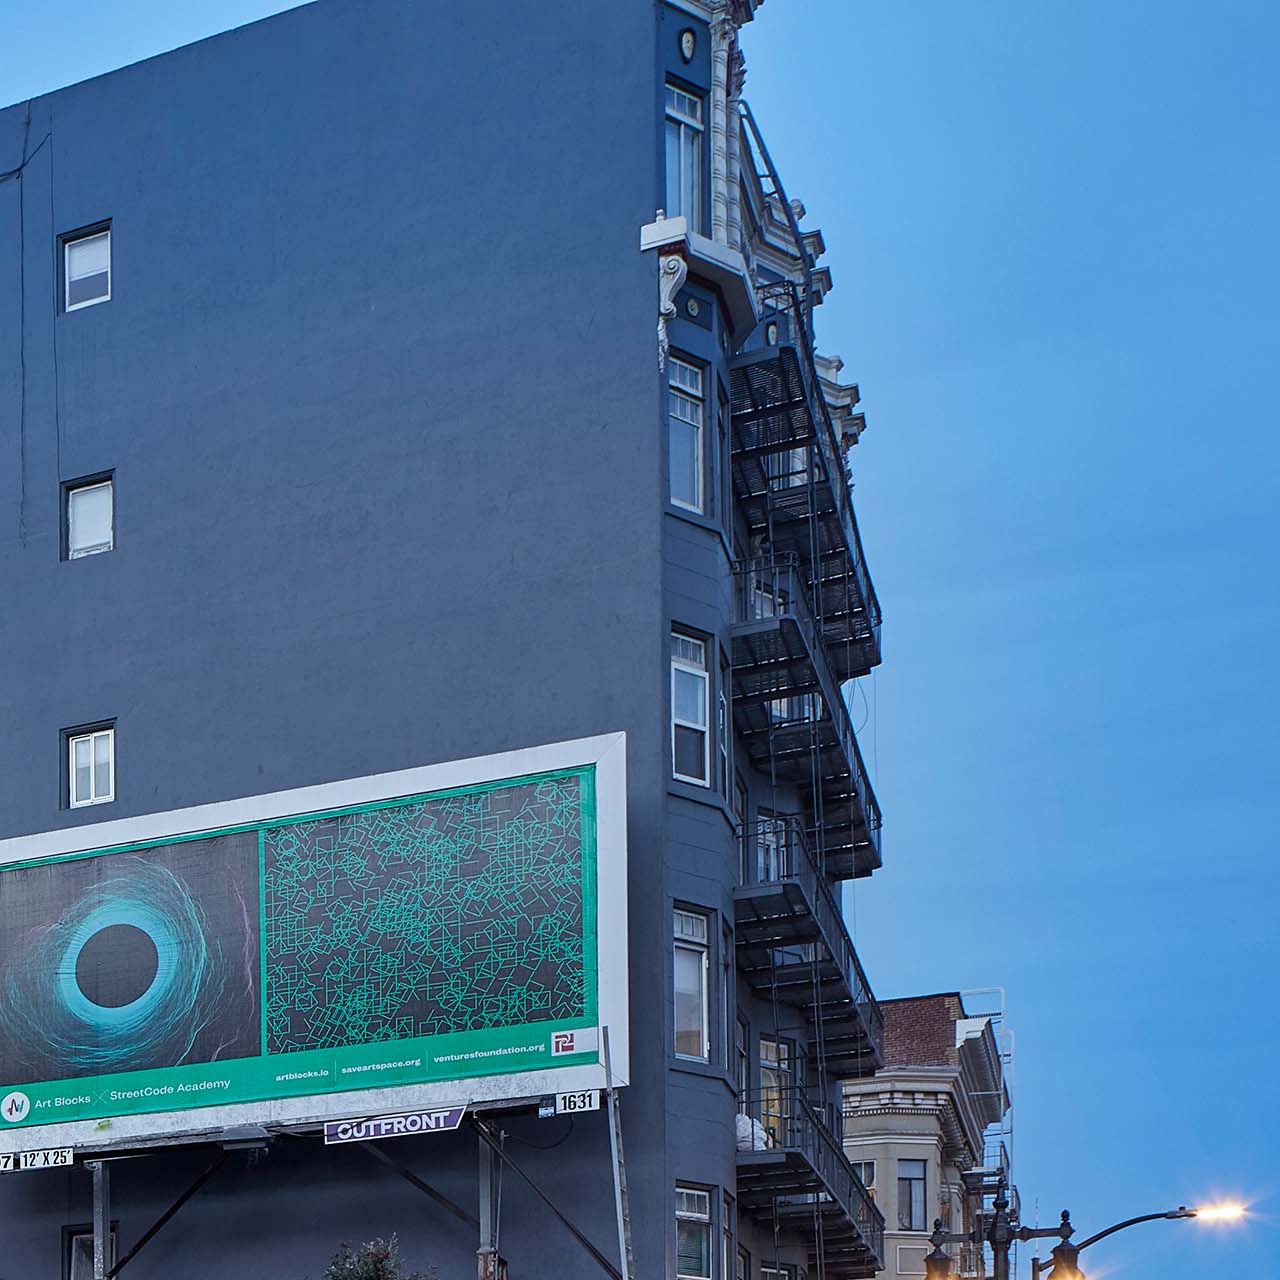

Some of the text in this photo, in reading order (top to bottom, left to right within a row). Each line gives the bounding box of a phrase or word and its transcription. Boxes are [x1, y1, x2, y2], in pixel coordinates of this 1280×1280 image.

[433, 1043, 546, 1063] venturesfoundation.org
[275, 1068, 329, 1082] artblocks.io
[341, 1057, 422, 1074] saveartspace.org
[34, 1098, 52, 1109] Art
[54, 1095, 91, 1107] Blocks
[109, 1085, 174, 1101] StreetCode
[176, 1079, 231, 1093] Academy
[561, 1093, 593, 1111] 1631
[336, 1111, 451, 1140] OUTFRONT
